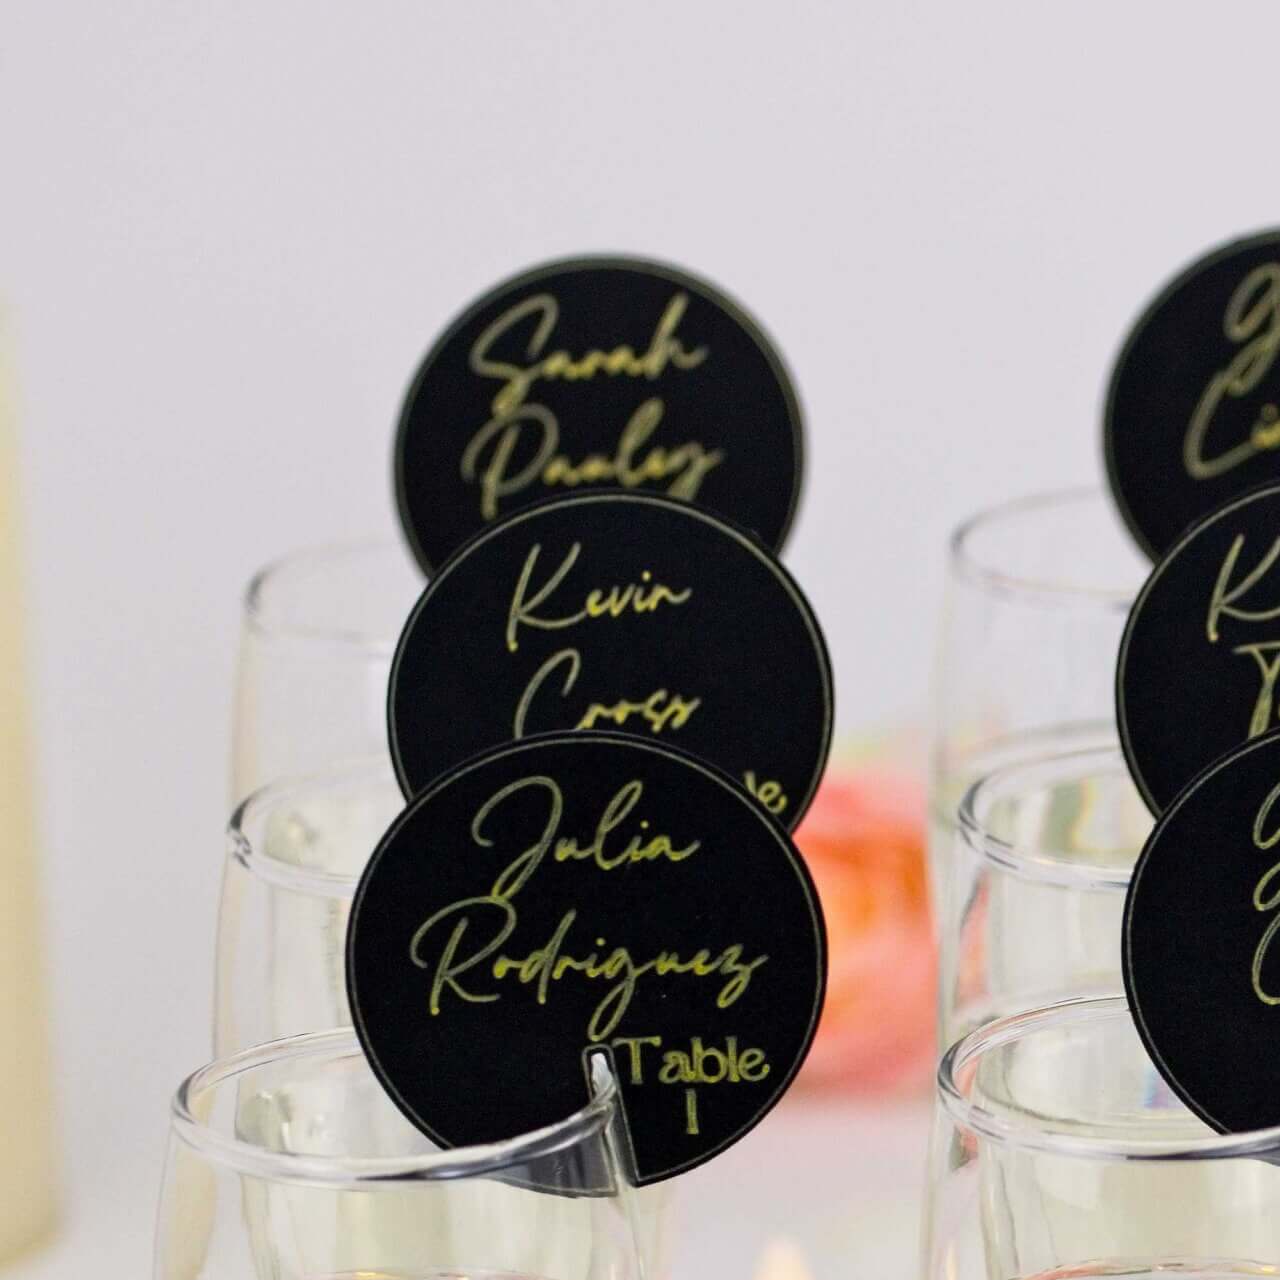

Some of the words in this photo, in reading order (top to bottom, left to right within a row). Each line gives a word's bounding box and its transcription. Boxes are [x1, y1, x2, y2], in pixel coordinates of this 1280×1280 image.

[469, 293, 710, 418] Sarah
[506, 541, 692, 652] Kevin
[513, 648, 701, 740] Cross
[471, 775, 700, 901] Julia
[410, 896, 769, 1041] Rodriguez
[612, 1035, 771, 1084] Table
